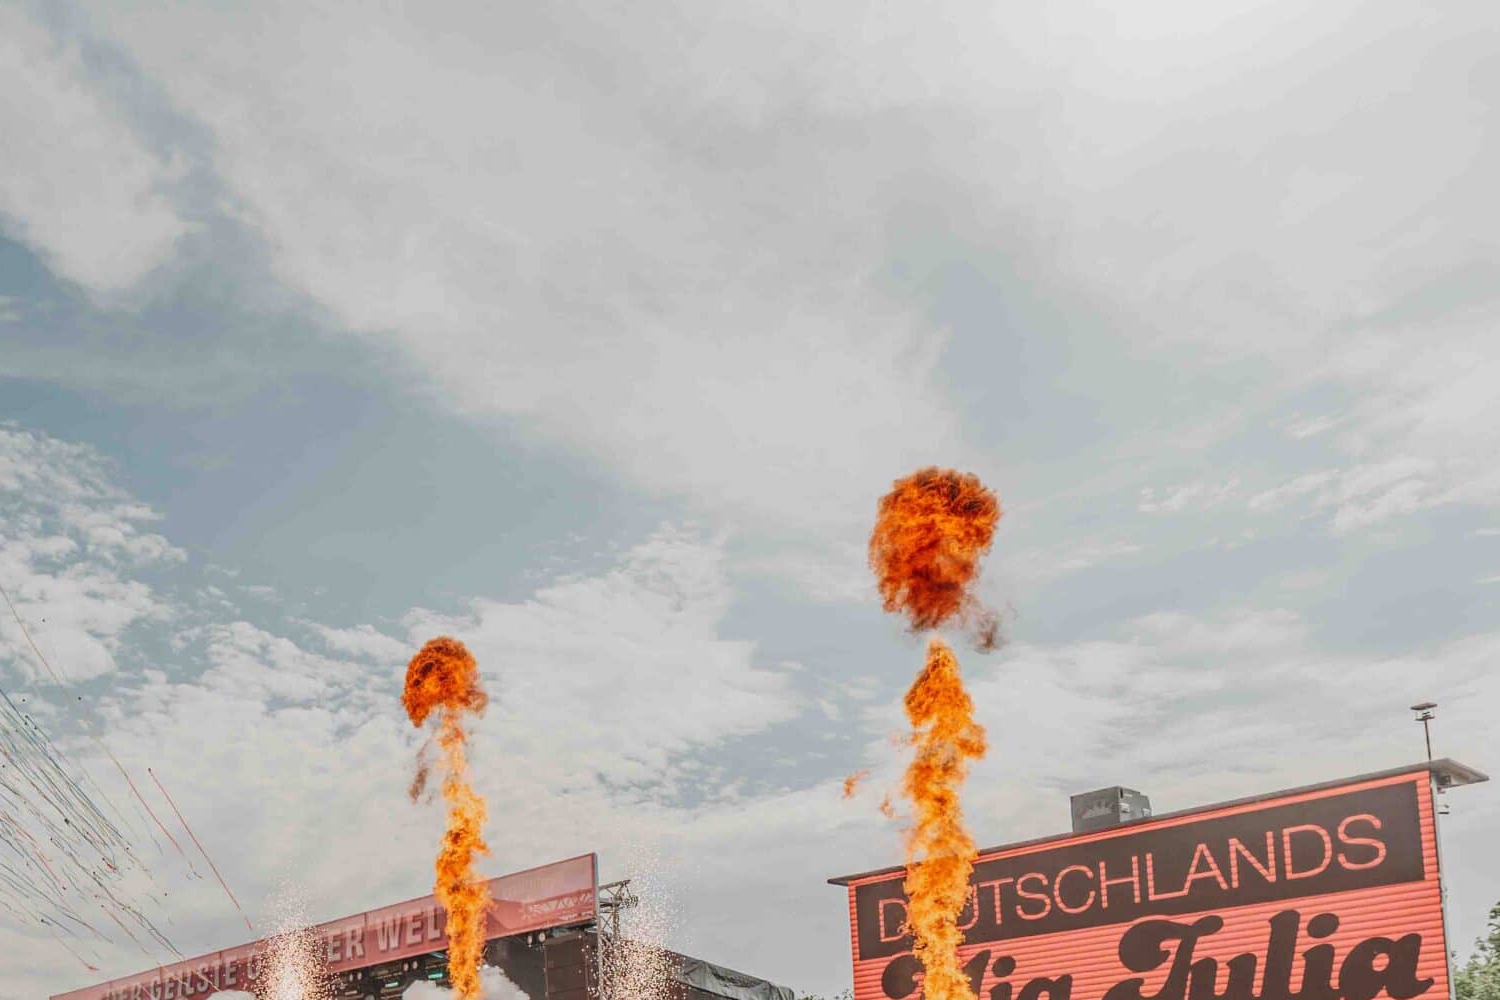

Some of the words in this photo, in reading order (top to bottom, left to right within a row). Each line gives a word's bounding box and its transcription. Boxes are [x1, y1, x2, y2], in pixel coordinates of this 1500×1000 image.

[878, 814, 1388, 943] DUTSCHLANDS
[326, 927, 365, 963] ER
[377, 905, 443, 951] WEL
